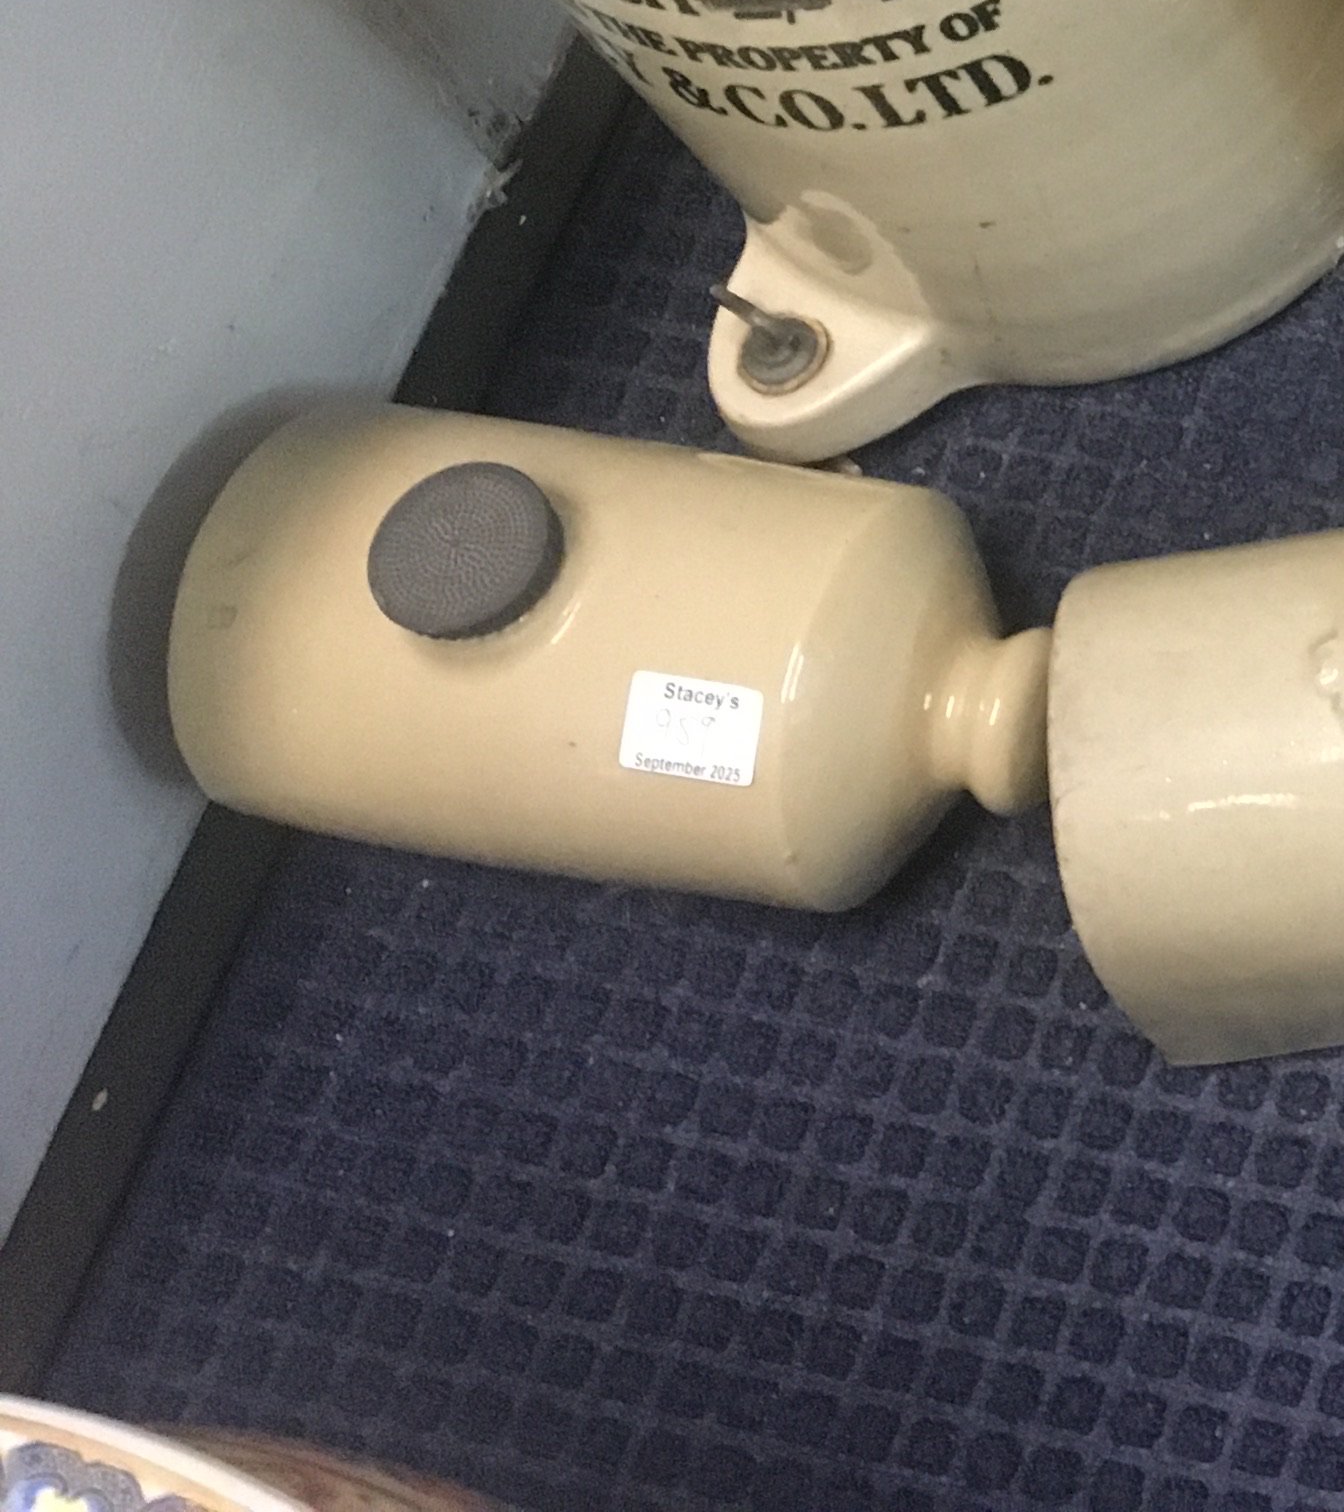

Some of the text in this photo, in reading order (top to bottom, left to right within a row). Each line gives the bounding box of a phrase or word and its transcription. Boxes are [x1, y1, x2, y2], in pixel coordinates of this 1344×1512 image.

[671, 24, 932, 71] PROPERTY
[660, 53, 1054, 130] & CO. LTD.
[663, 681, 740, 711] Stacey's
[634, 752, 741, 783] September 2025
